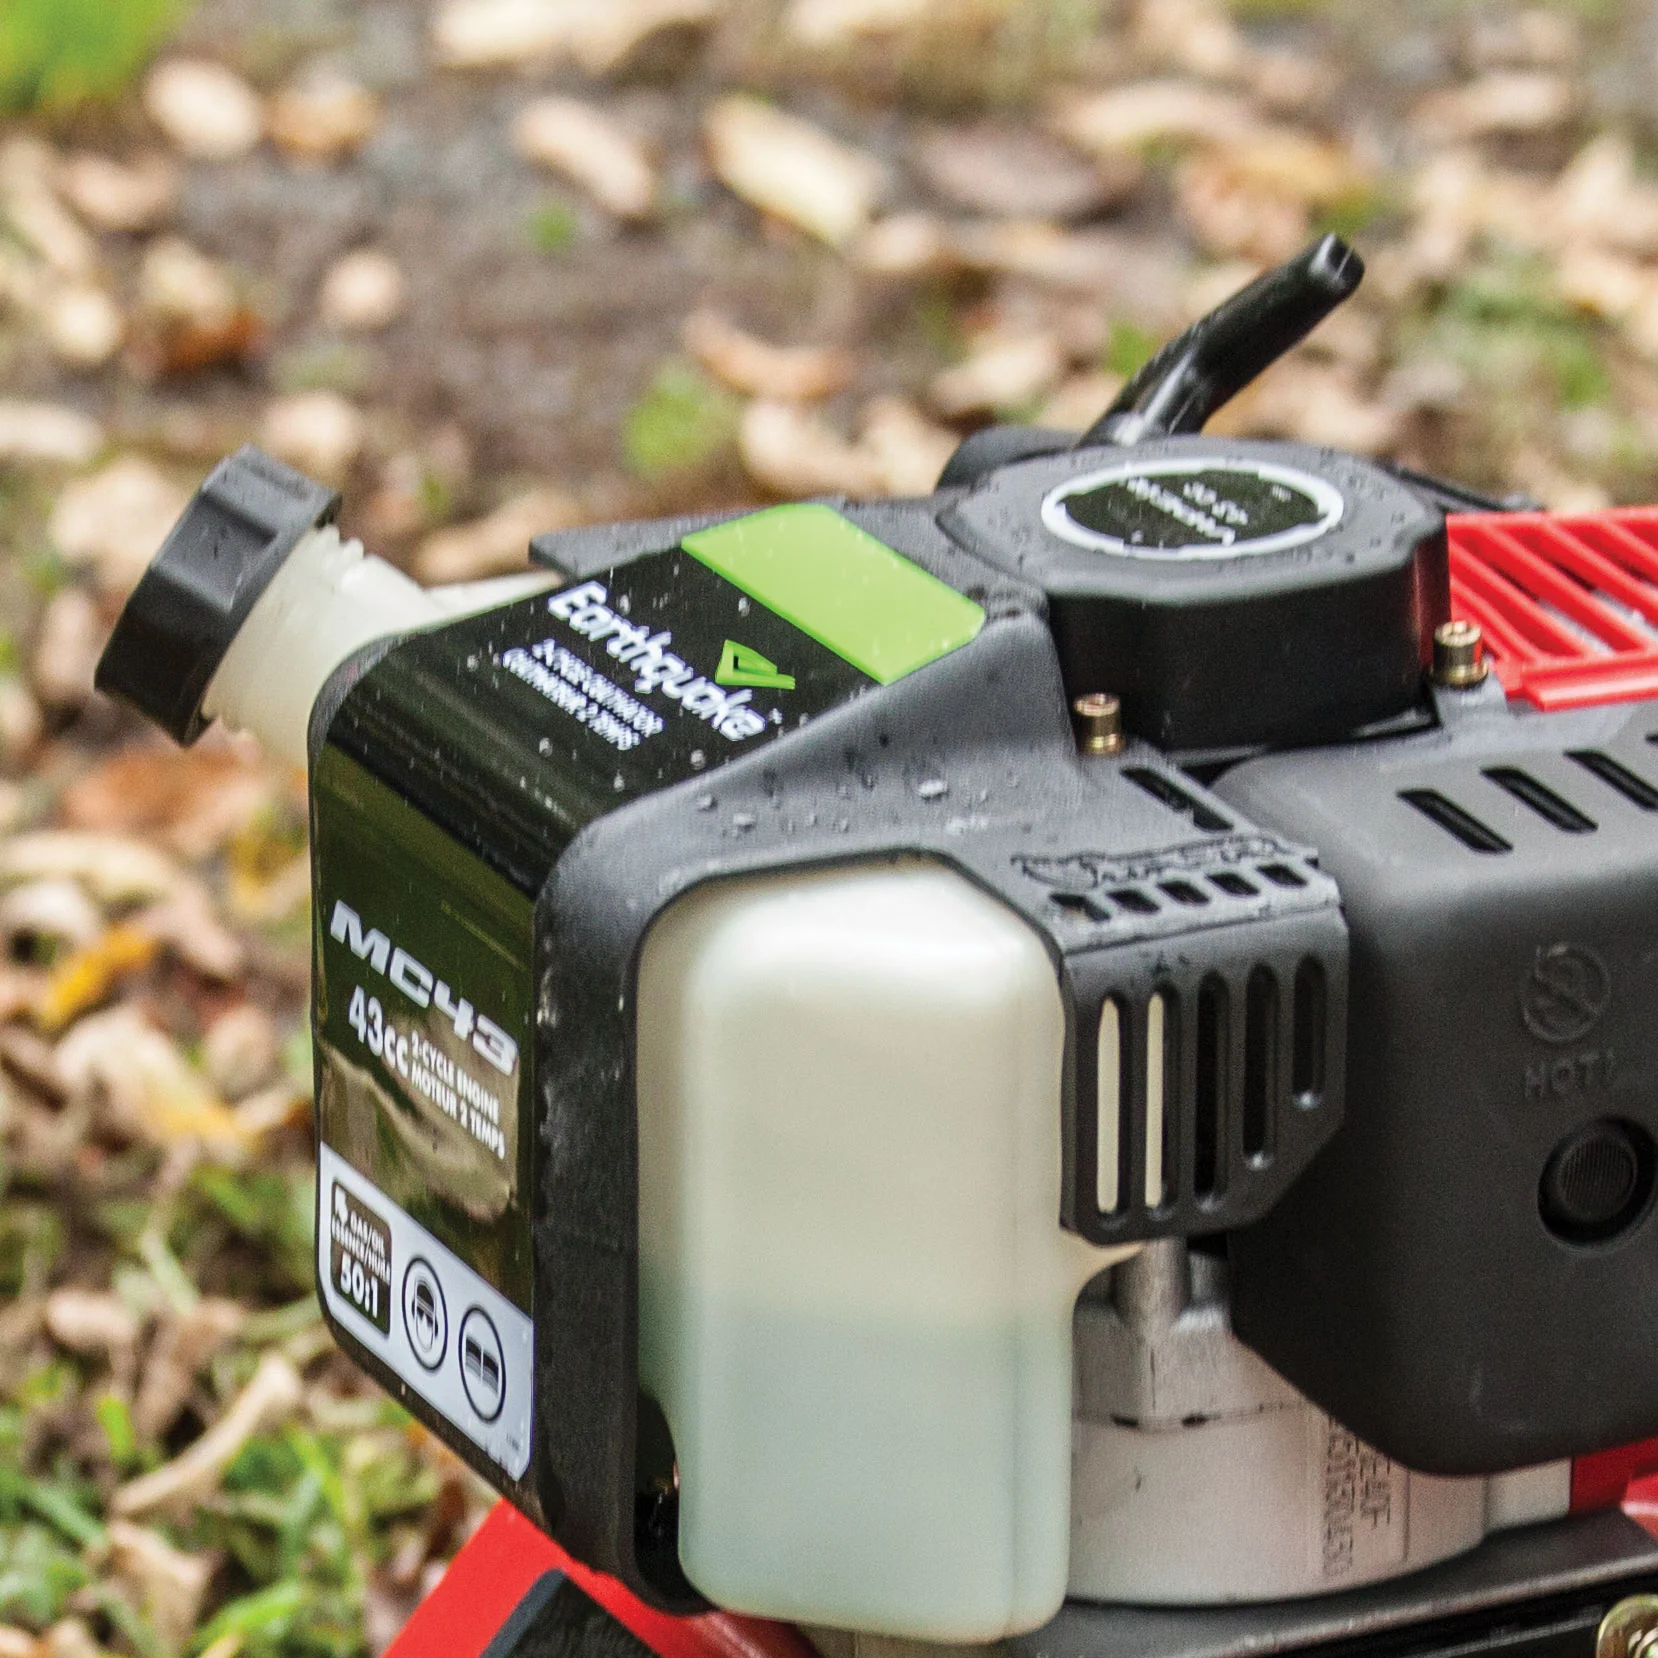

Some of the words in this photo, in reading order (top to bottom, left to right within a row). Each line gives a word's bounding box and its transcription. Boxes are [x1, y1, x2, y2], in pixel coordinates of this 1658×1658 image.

[548, 580, 766, 741] Earthquake
[330, 899, 519, 1077] MC43
[340, 1250, 379, 1319] 50:1
